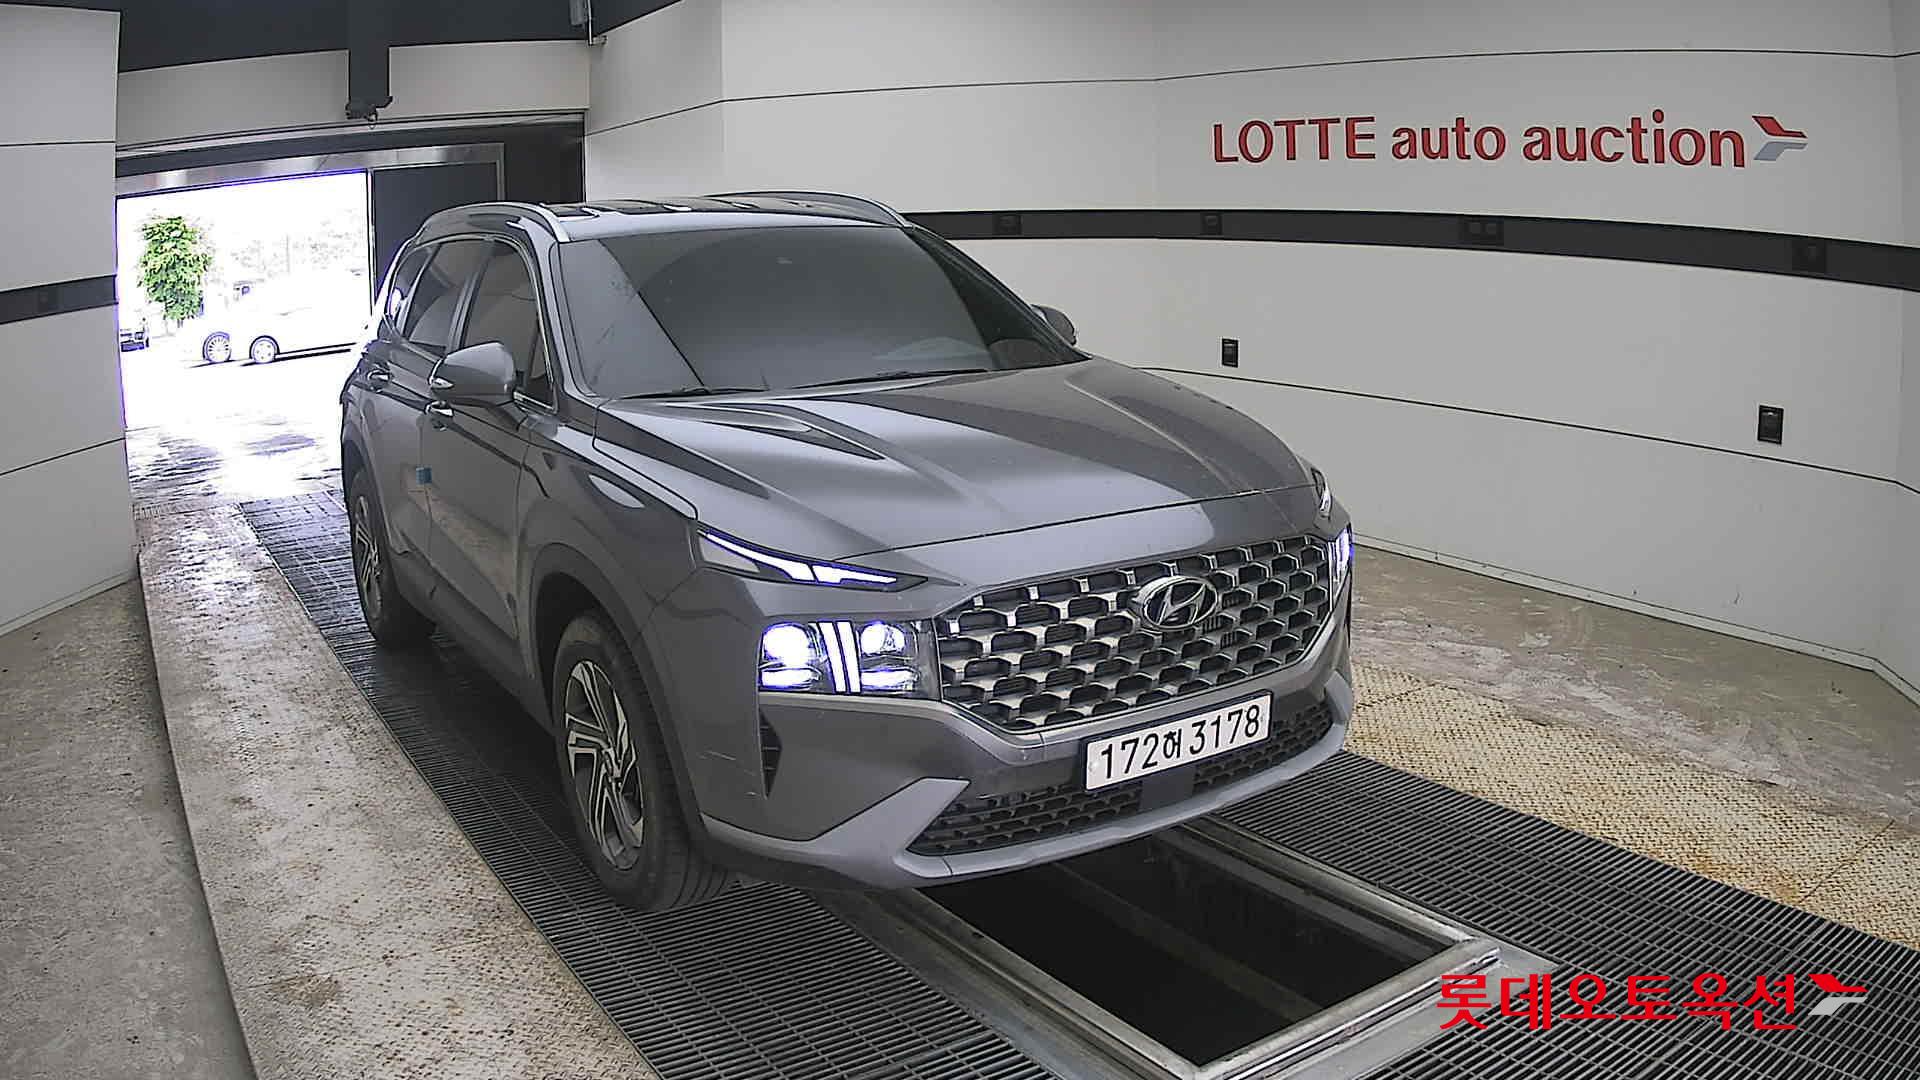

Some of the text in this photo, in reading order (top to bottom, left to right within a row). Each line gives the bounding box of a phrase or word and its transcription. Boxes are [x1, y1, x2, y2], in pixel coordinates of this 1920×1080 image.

[1212, 109, 1746, 168] LOTTE auto auction
